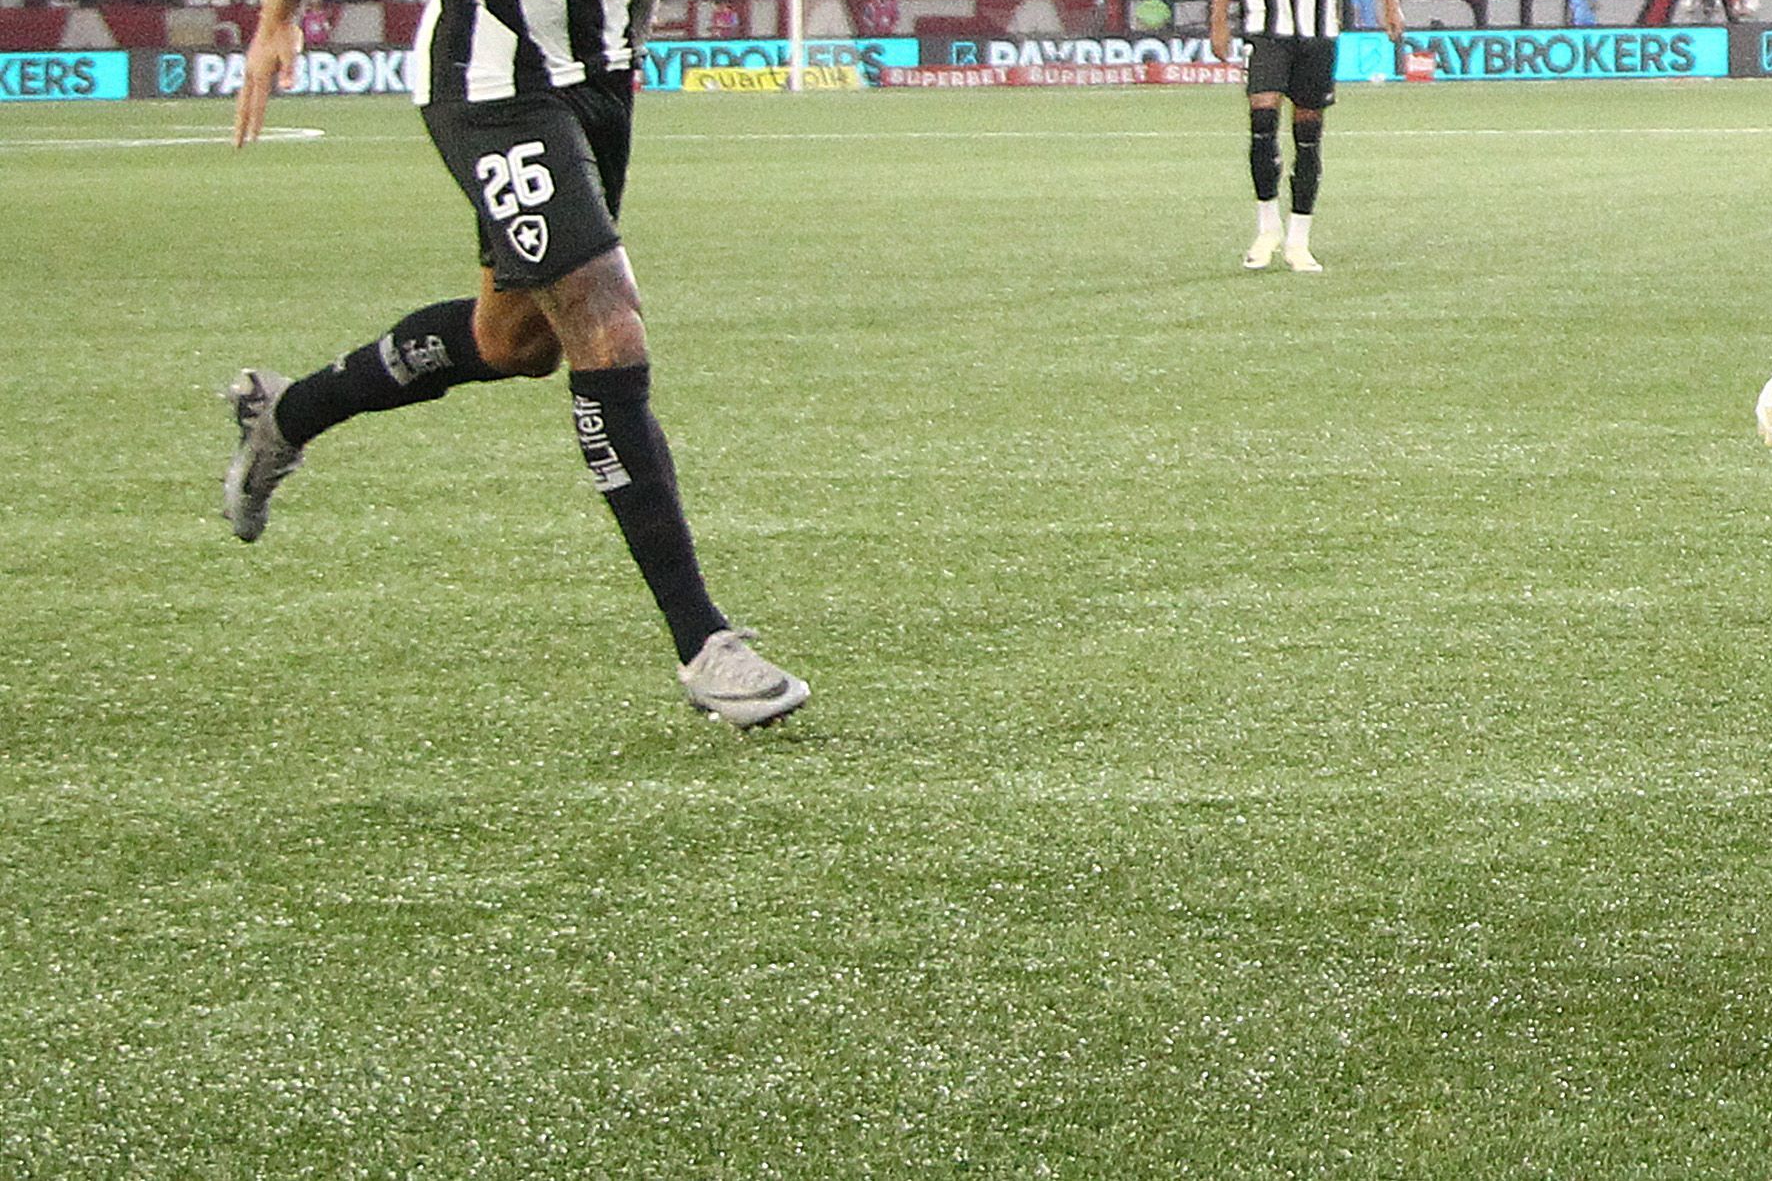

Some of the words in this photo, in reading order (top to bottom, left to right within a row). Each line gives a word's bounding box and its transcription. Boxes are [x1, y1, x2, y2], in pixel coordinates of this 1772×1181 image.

[1402, 33, 1696, 75] PAYBROKERS
[889, 66, 1008, 87] SUPERBET
[1030, 65, 1148, 85] SUPERBET
[475, 141, 555, 219] 26
